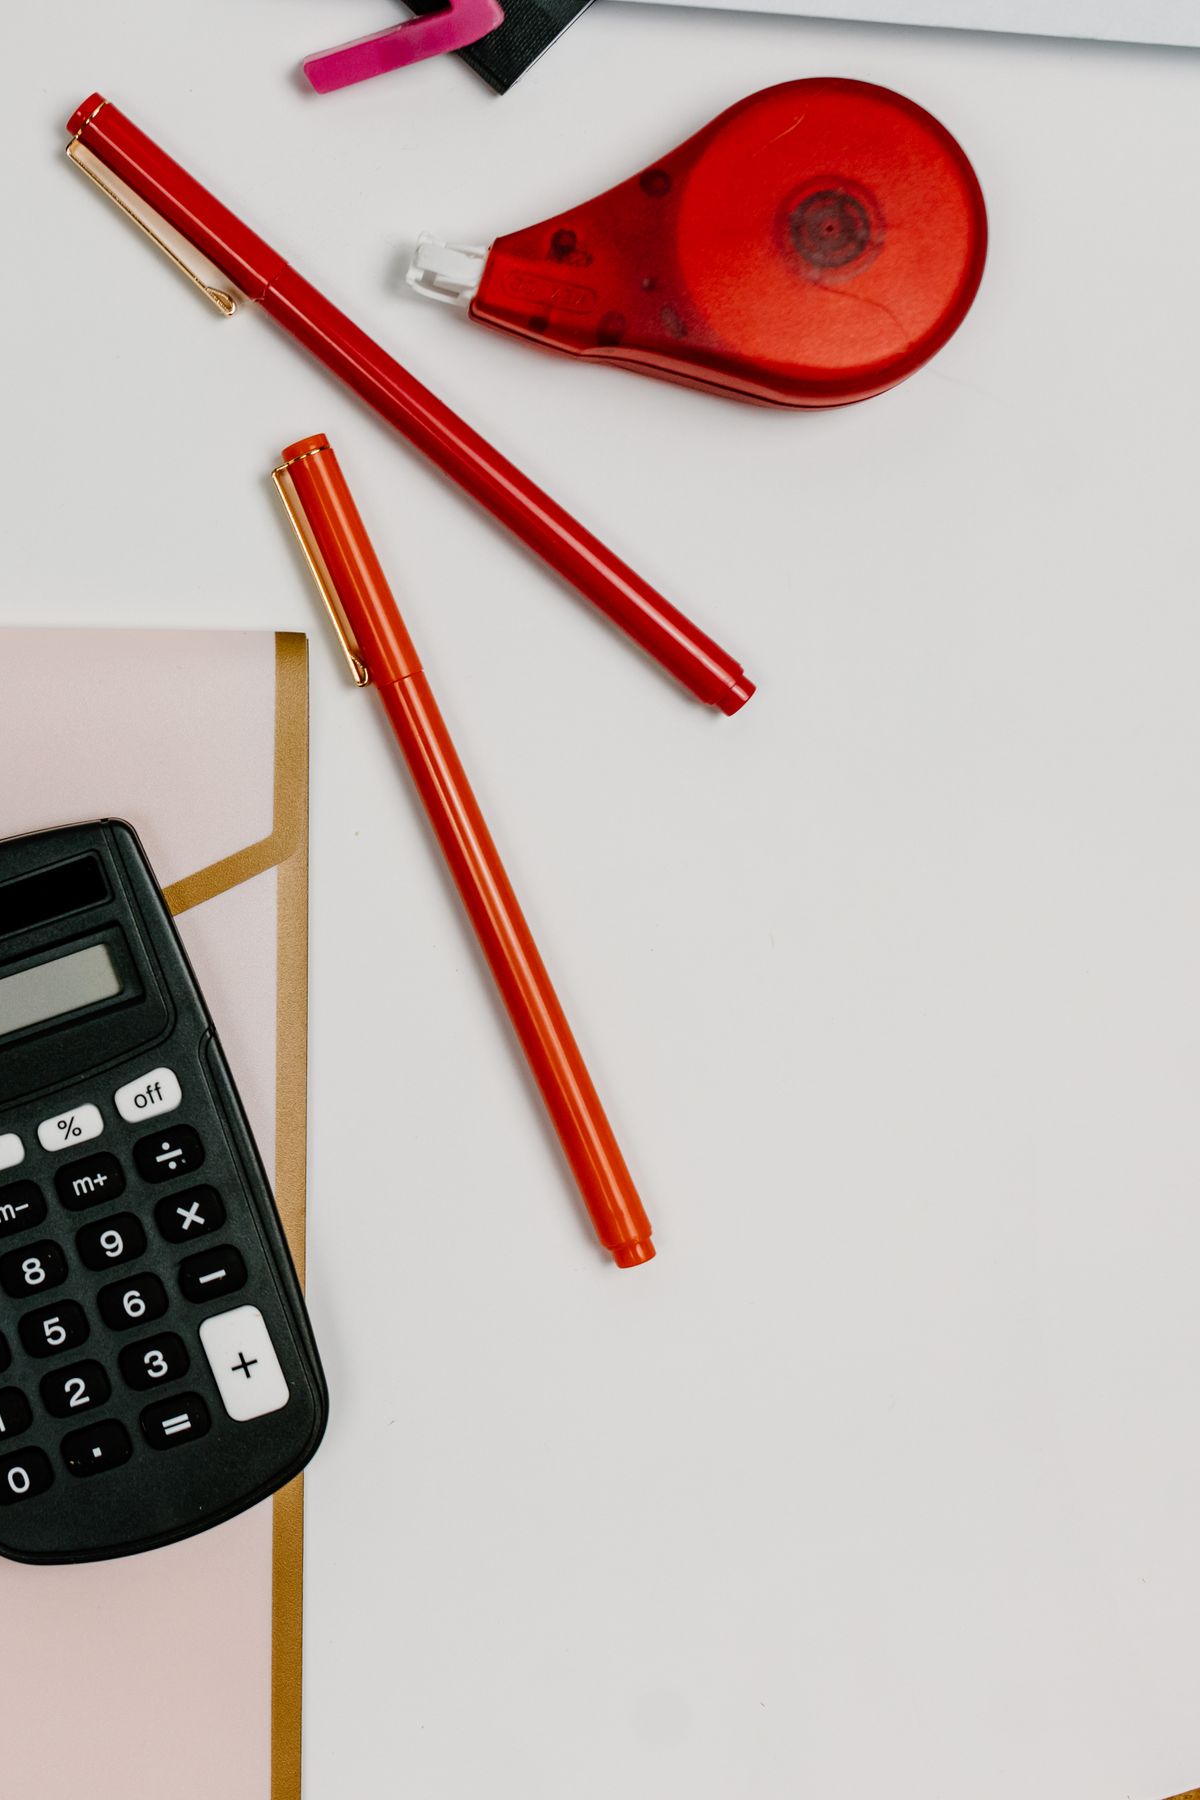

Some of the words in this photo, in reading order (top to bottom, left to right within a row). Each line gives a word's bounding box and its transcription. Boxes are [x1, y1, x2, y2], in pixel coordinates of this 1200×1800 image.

[133, 1080, 164, 1109] off
[72, 1172, 108, 1196] m+
[100, 1230, 124, 1258] 9
[21, 1257, 46, 1285] 8
[122, 1290, 146, 1318] 6
[43, 1316, 67, 1346] 5
[143, 1350, 168, 1378] 3
[64, 1377, 90, 1408] 2
[7, 1466, 30, 1494] 0
